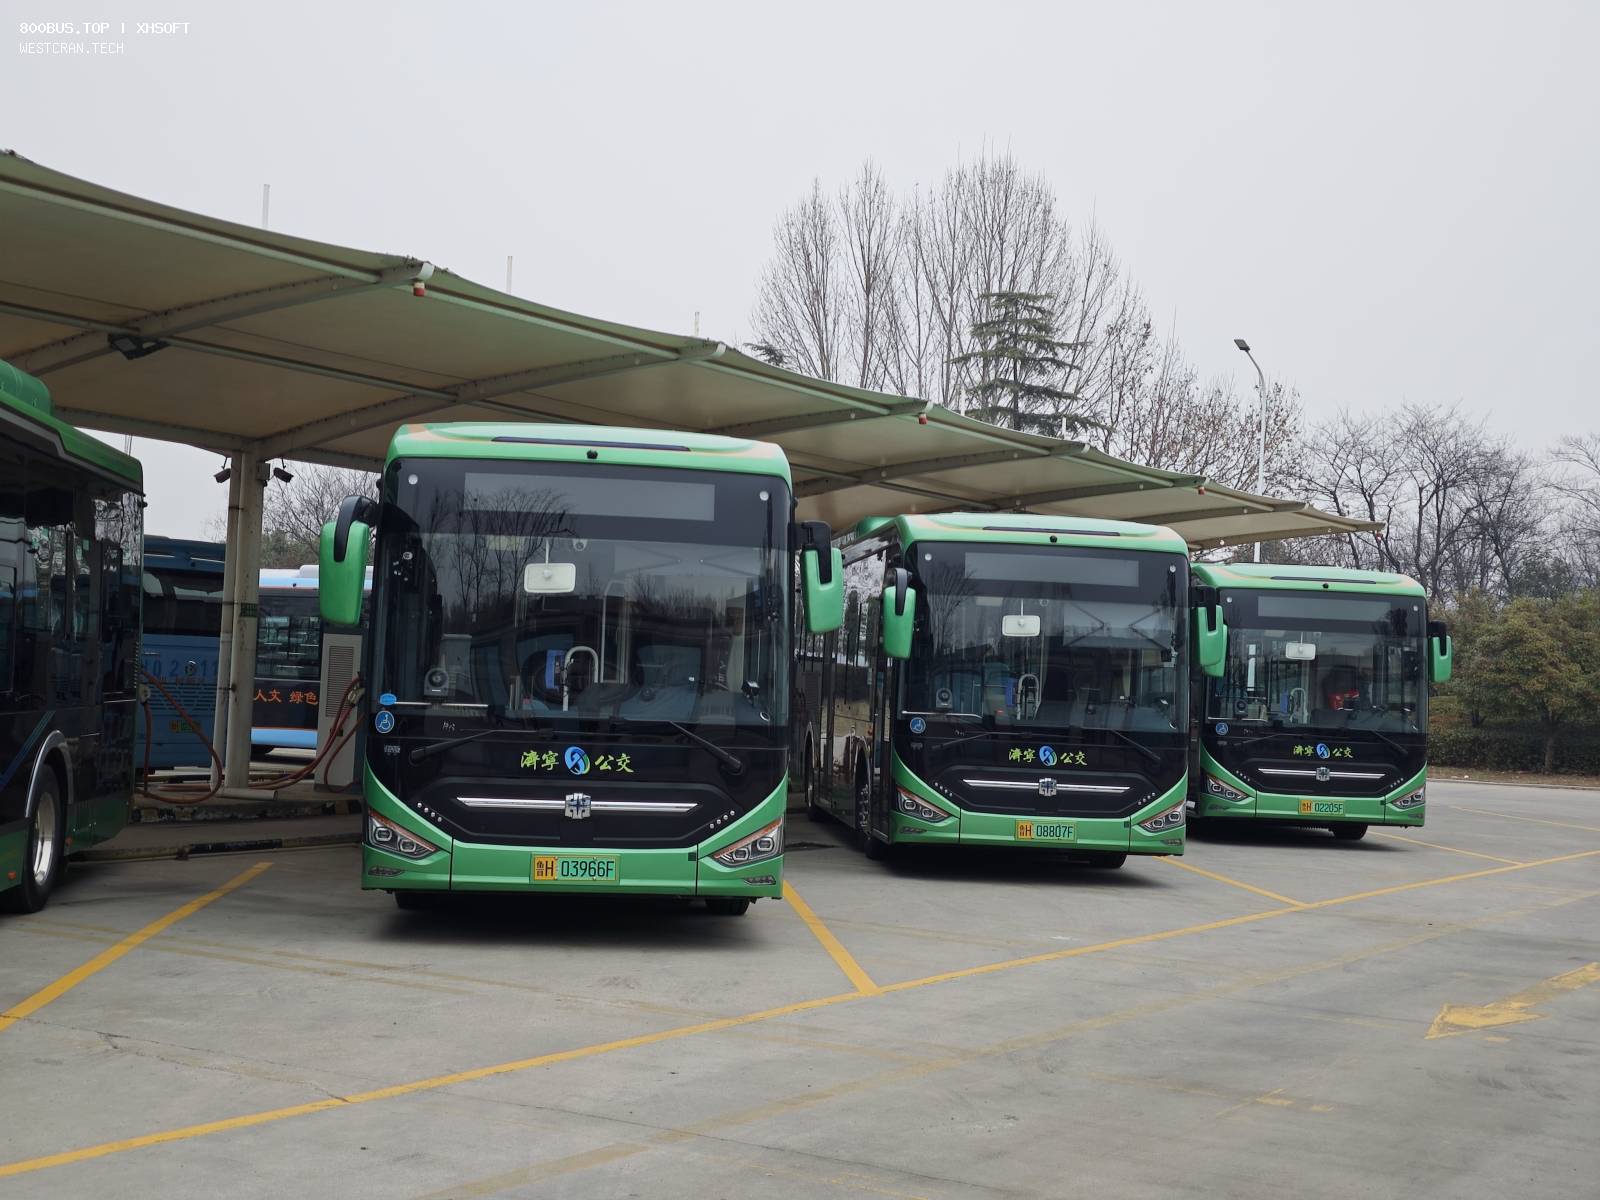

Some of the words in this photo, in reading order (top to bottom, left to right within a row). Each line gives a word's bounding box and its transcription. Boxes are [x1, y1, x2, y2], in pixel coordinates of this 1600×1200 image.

[1060, 751, 1088, 766] 公交
[1332, 747, 1354, 759] 公交
[520, 750, 560, 771] 濟寧
[594, 752, 635, 773] 公交
[1036, 824, 1074, 838] 08807F
[535, 859, 555, 877] 鲁H
[560, 860, 616, 878] 03966F
